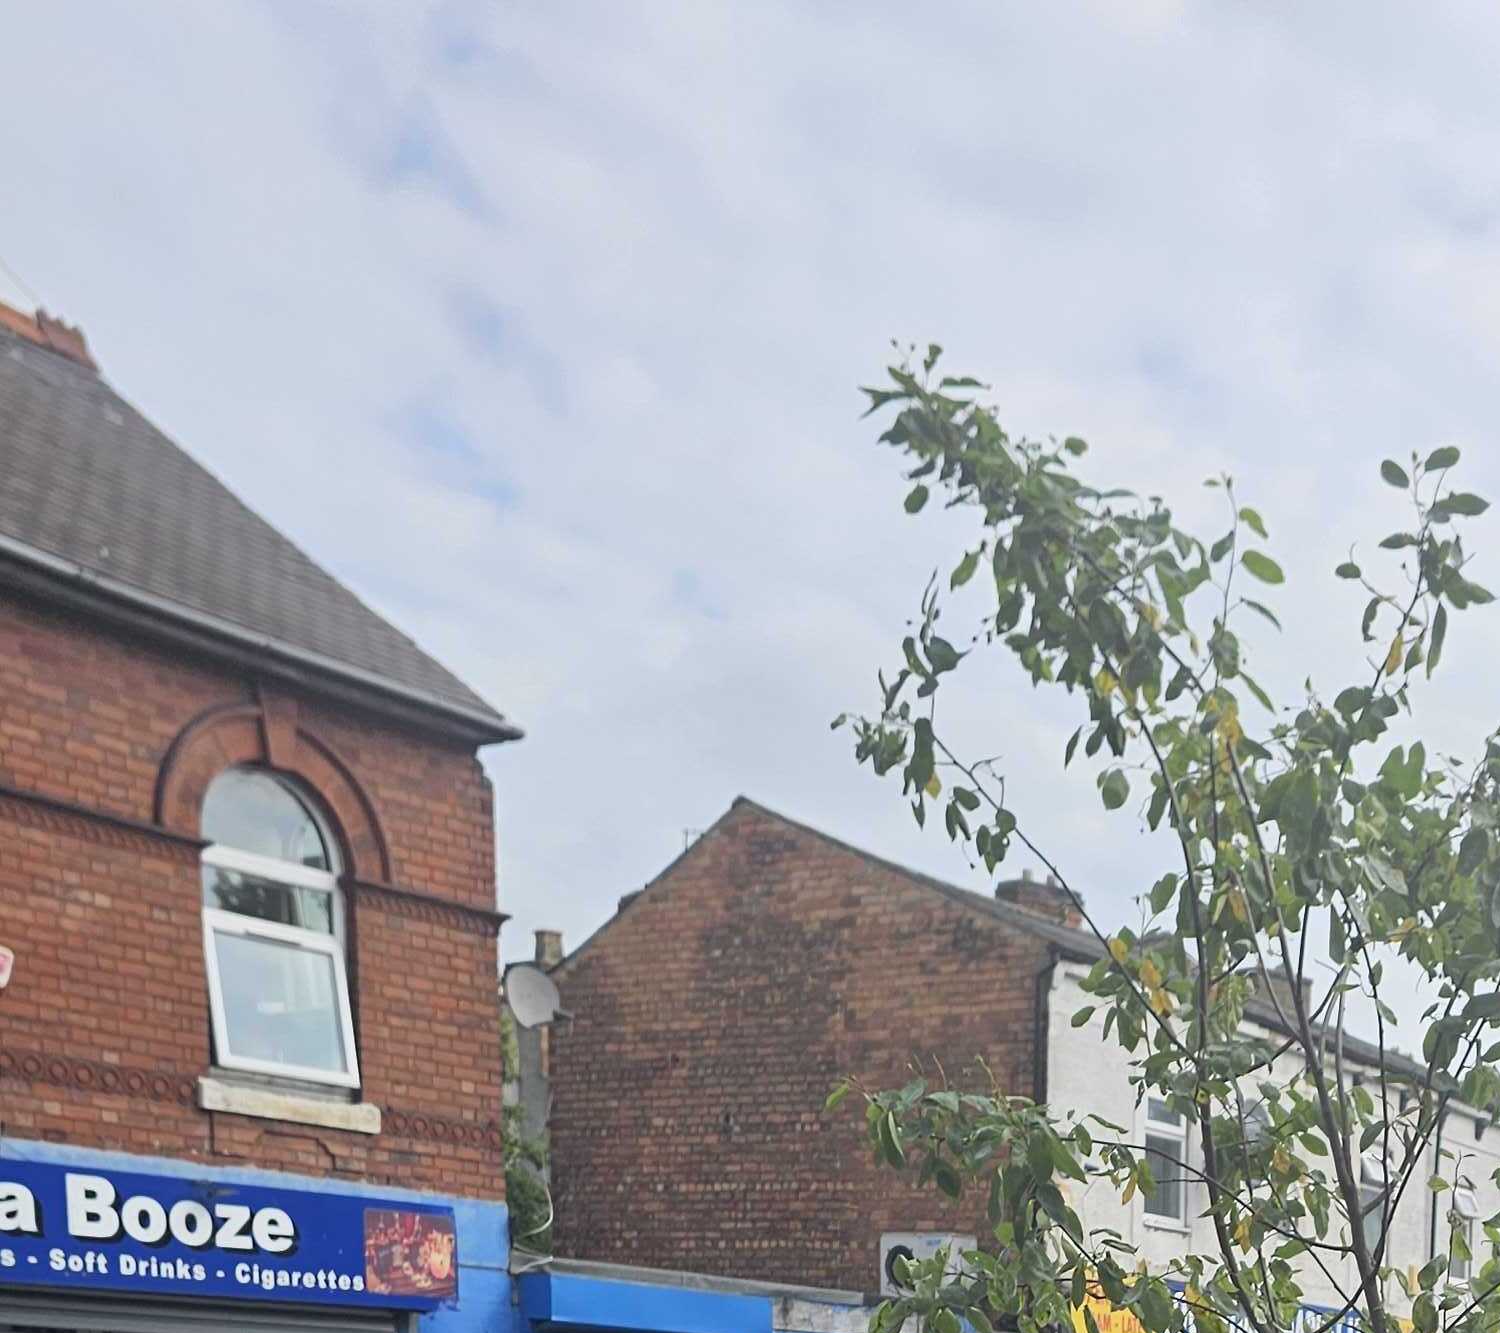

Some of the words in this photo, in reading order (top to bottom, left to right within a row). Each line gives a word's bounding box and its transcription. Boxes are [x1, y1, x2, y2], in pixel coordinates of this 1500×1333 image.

[64, 1172, 296, 1253] Booze
[49, 1248, 108, 1275] Soft
[119, 1253, 206, 1281] Drinks
[235, 1262, 365, 1291] Cigarettes
